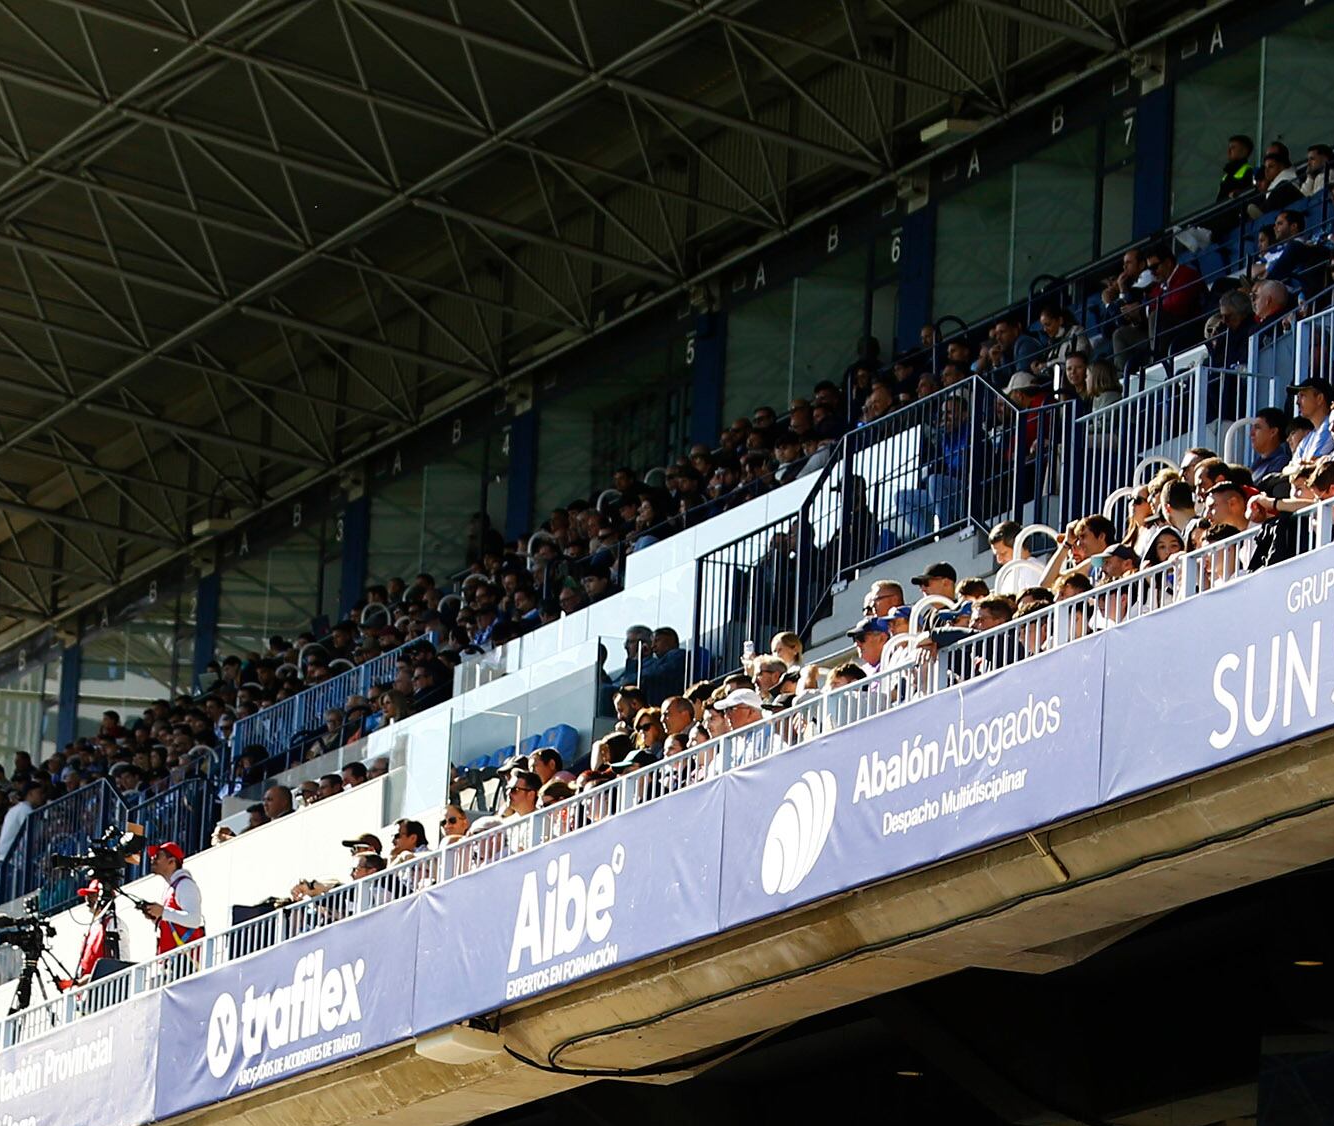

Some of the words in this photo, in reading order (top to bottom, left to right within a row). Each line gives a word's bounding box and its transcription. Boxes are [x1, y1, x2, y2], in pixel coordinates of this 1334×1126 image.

[1209, 24, 1224, 54] A
[1051, 104, 1064, 135] B
[967, 151, 980, 179] A
[827, 224, 839, 253] B
[890, 234, 901, 263] 6
[754, 262, 766, 289] A
[452, 418, 463, 445] B
[392, 450, 403, 473] A
[853, 734, 943, 804] Abalón
[940, 694, 1061, 774] Abogados
[882, 797, 940, 836] Despacho
[941, 768, 1028, 816] Multidisciplinar
[506, 967, 550, 1000] EXPERTOS
[548, 963, 564, 986] EN
[563, 941, 619, 980] FORMACIÓN
[241, 948, 366, 1059] trafilex
[43, 1027, 114, 1087] Provincial
[238, 1059, 275, 1086] ABOGADOS
[284, 1044, 323, 1071] ACCIDENTES
